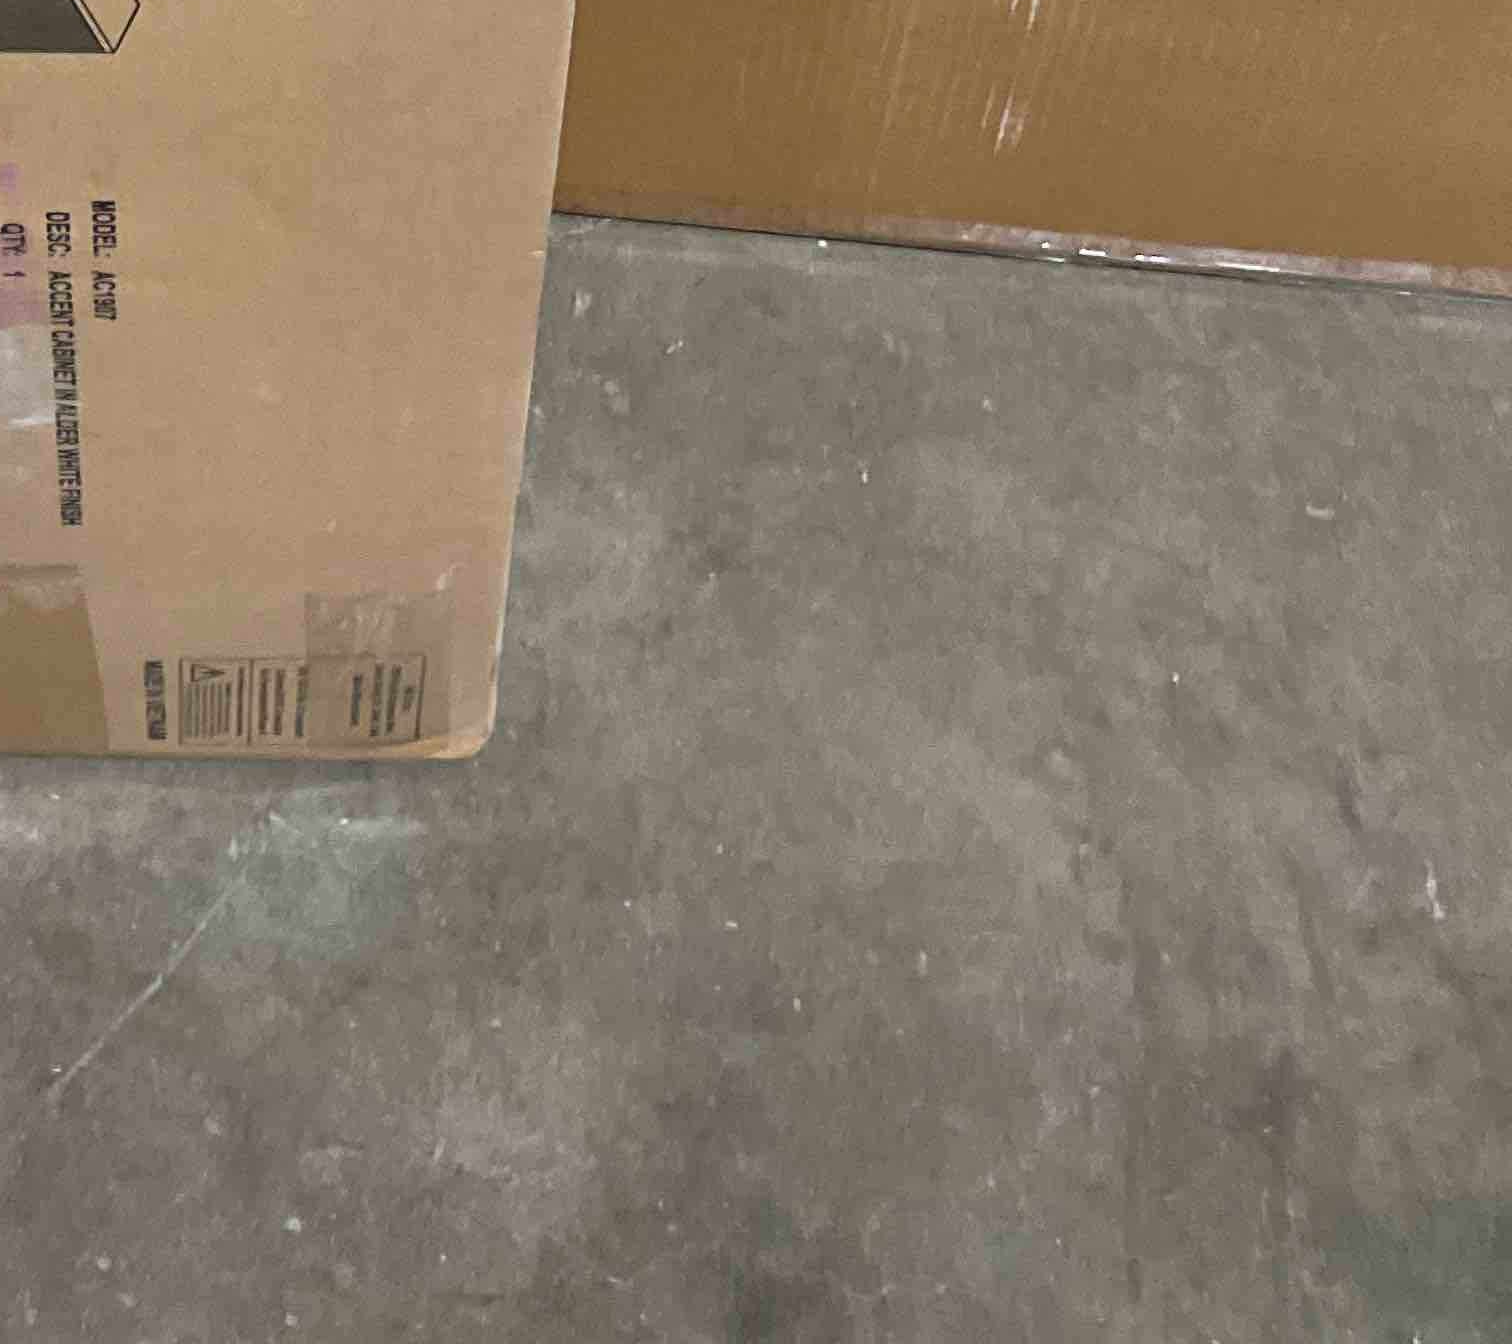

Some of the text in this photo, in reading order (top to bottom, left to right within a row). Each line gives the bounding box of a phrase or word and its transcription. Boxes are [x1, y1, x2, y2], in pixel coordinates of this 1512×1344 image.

[0, 222, 27, 257] QTY:
[46, 211, 72, 257] DESC:
[91, 199, 117, 258] MODEL:
[47, 270, 74, 328] ACCENT
[50, 328, 78, 389] CABINET
[57, 447, 81, 487] WHITE
